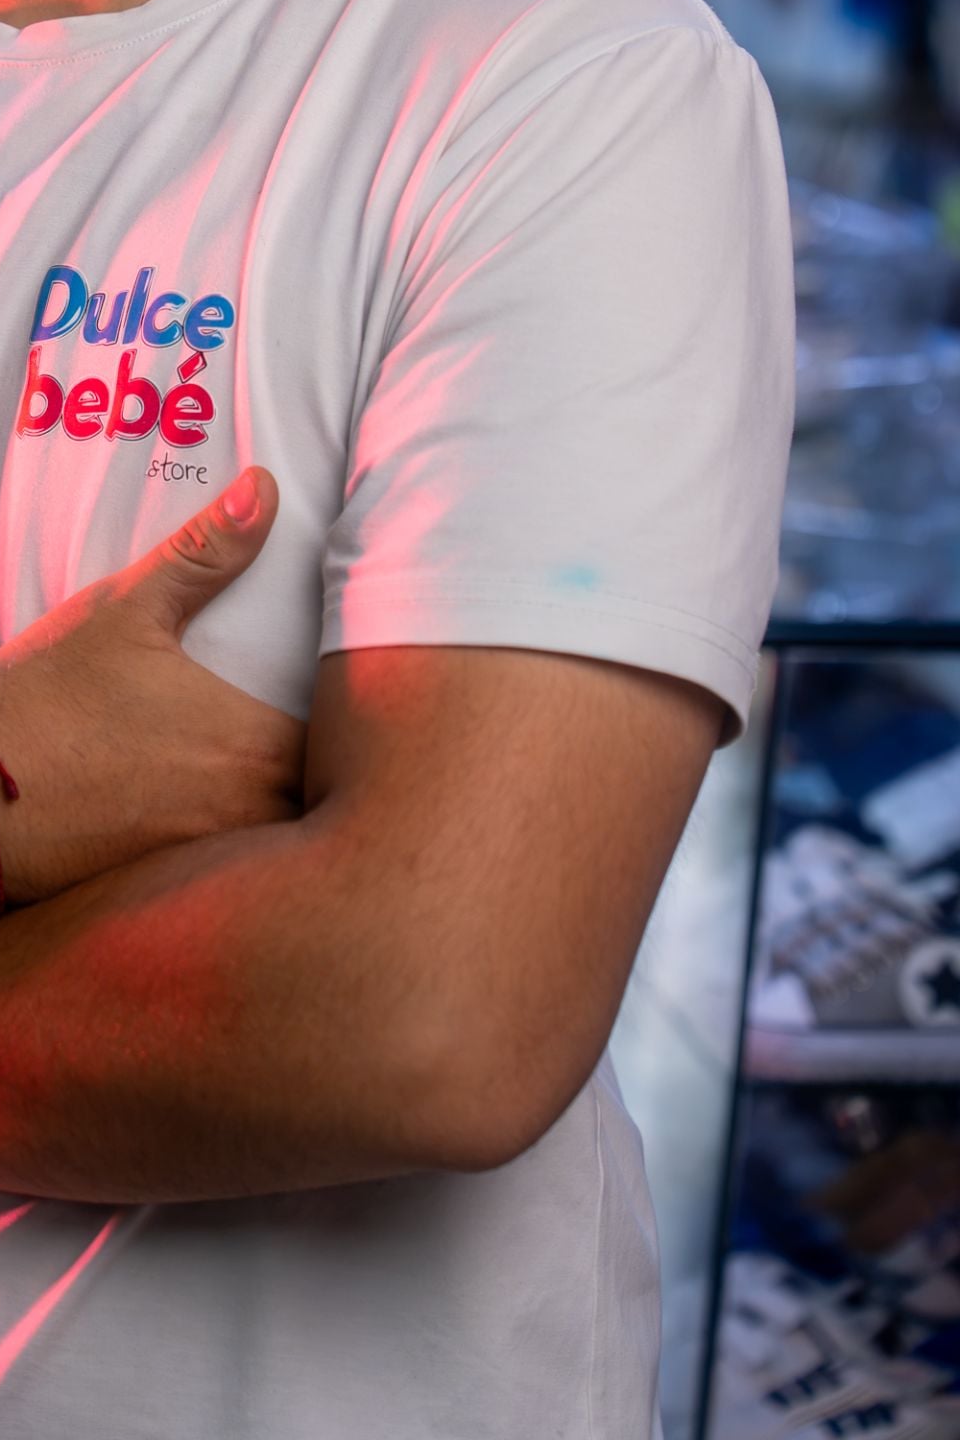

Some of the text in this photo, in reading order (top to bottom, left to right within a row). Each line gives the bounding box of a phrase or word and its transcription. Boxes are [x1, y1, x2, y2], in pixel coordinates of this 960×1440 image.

[29, 264, 235, 351] Dulce
[15, 346, 216, 448] bebé
[147, 451, 208, 484] store
